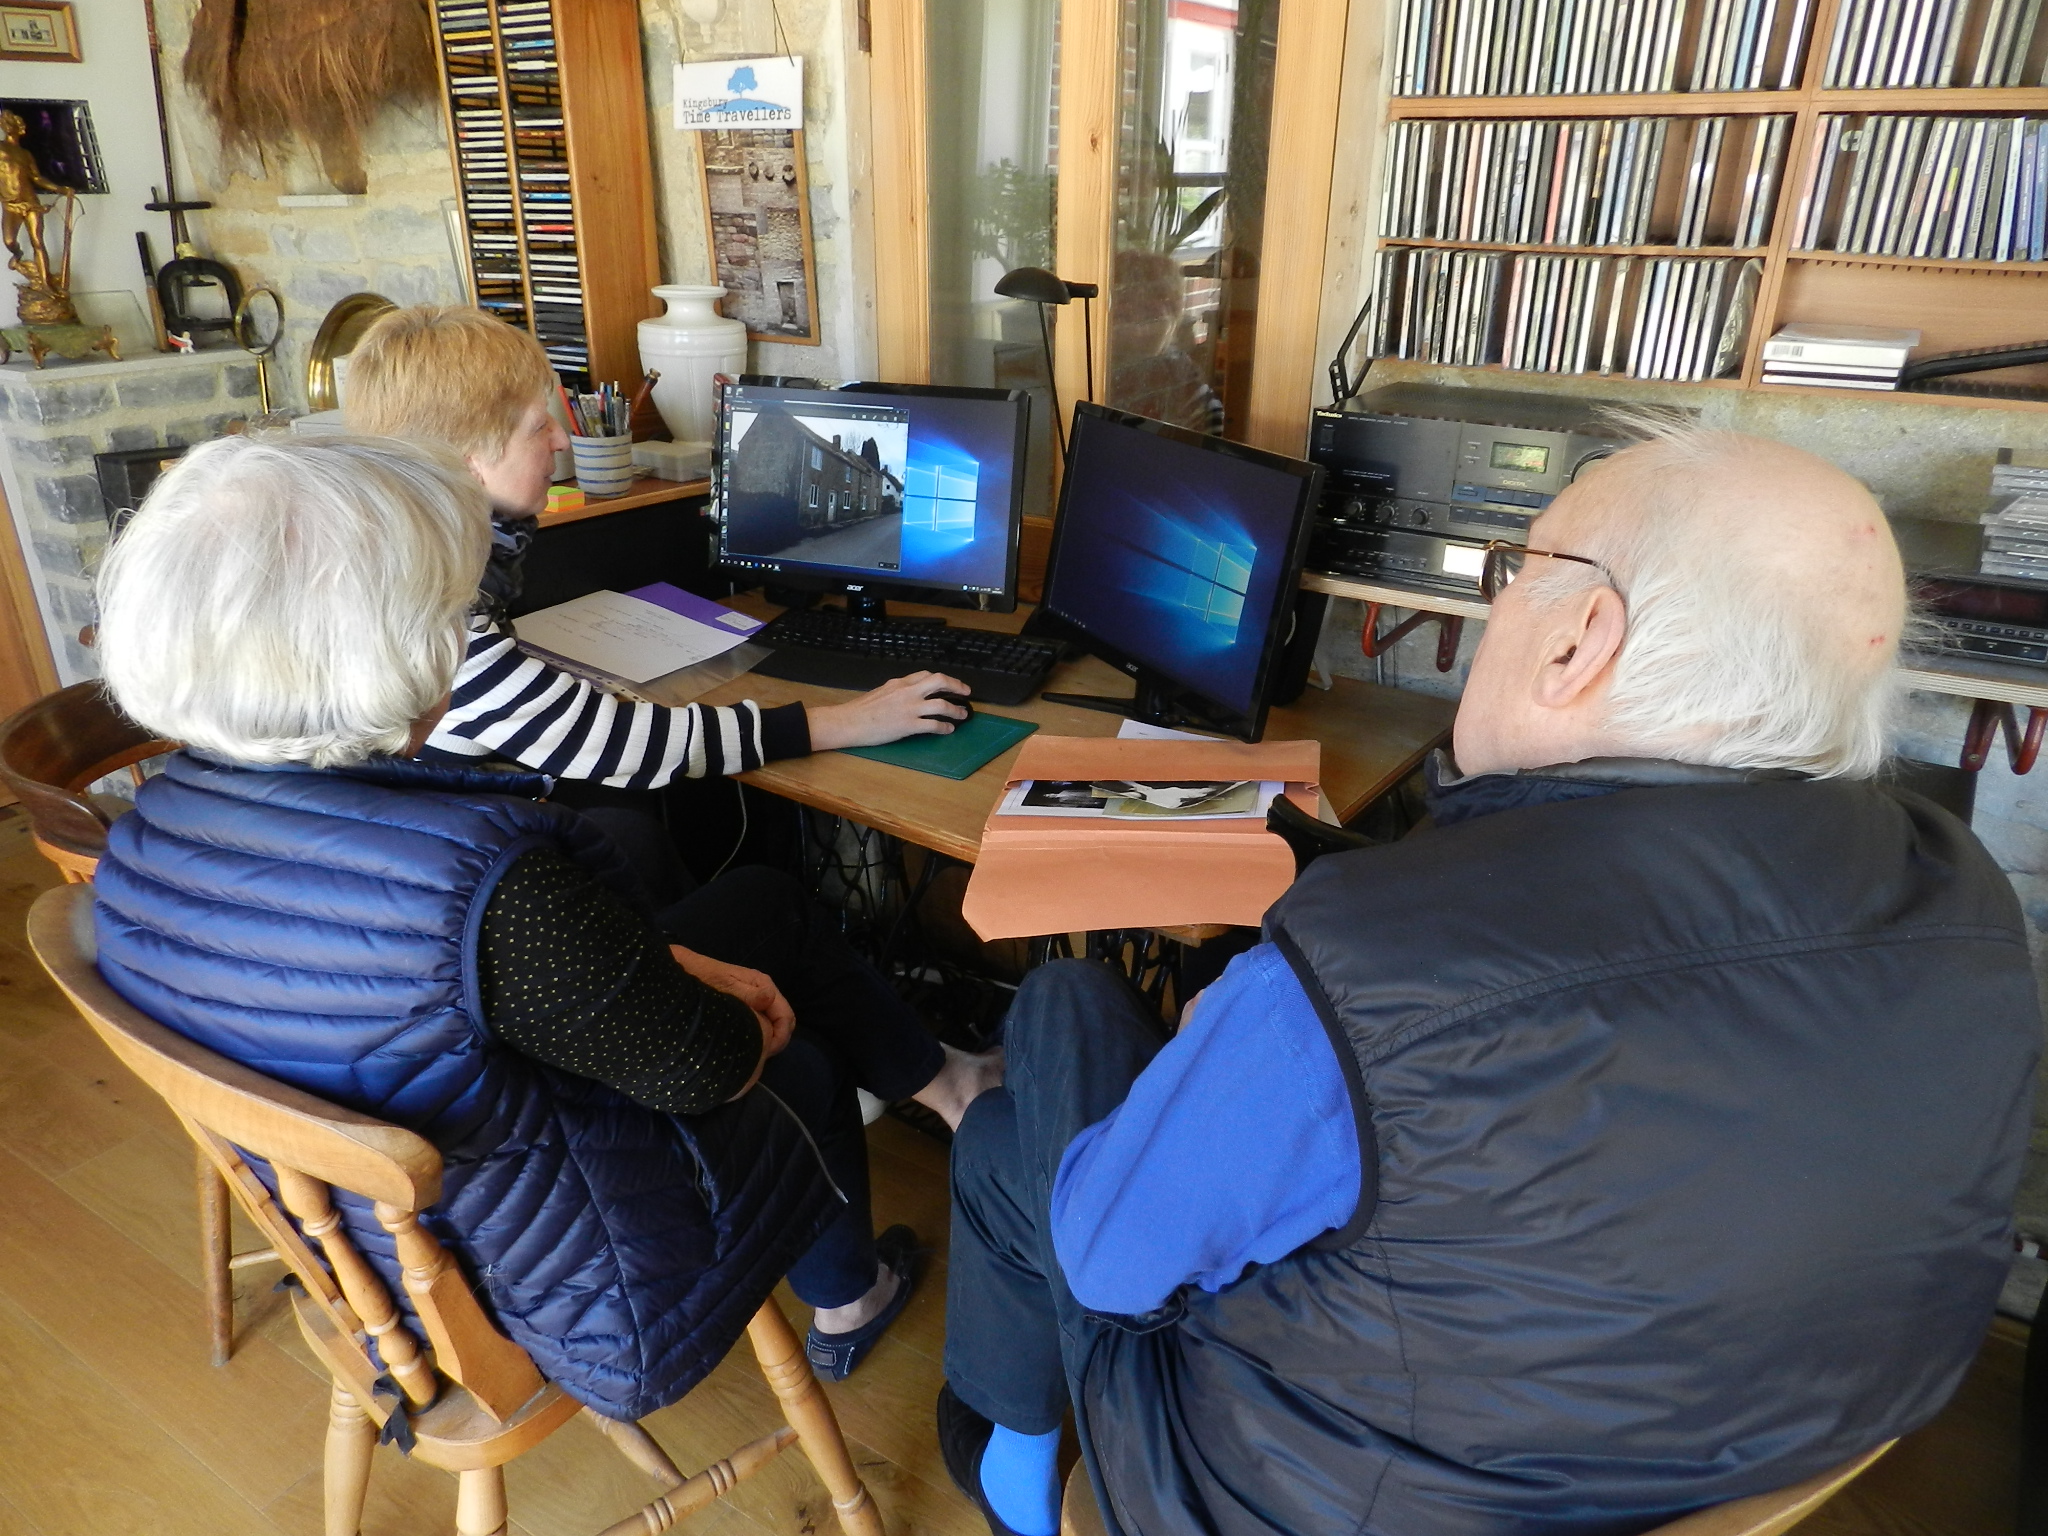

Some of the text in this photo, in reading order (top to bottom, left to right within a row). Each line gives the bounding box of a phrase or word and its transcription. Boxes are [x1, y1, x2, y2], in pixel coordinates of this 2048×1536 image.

[683, 98, 728, 110] Kingsbury
[683, 106, 792, 124] Time Travellers
